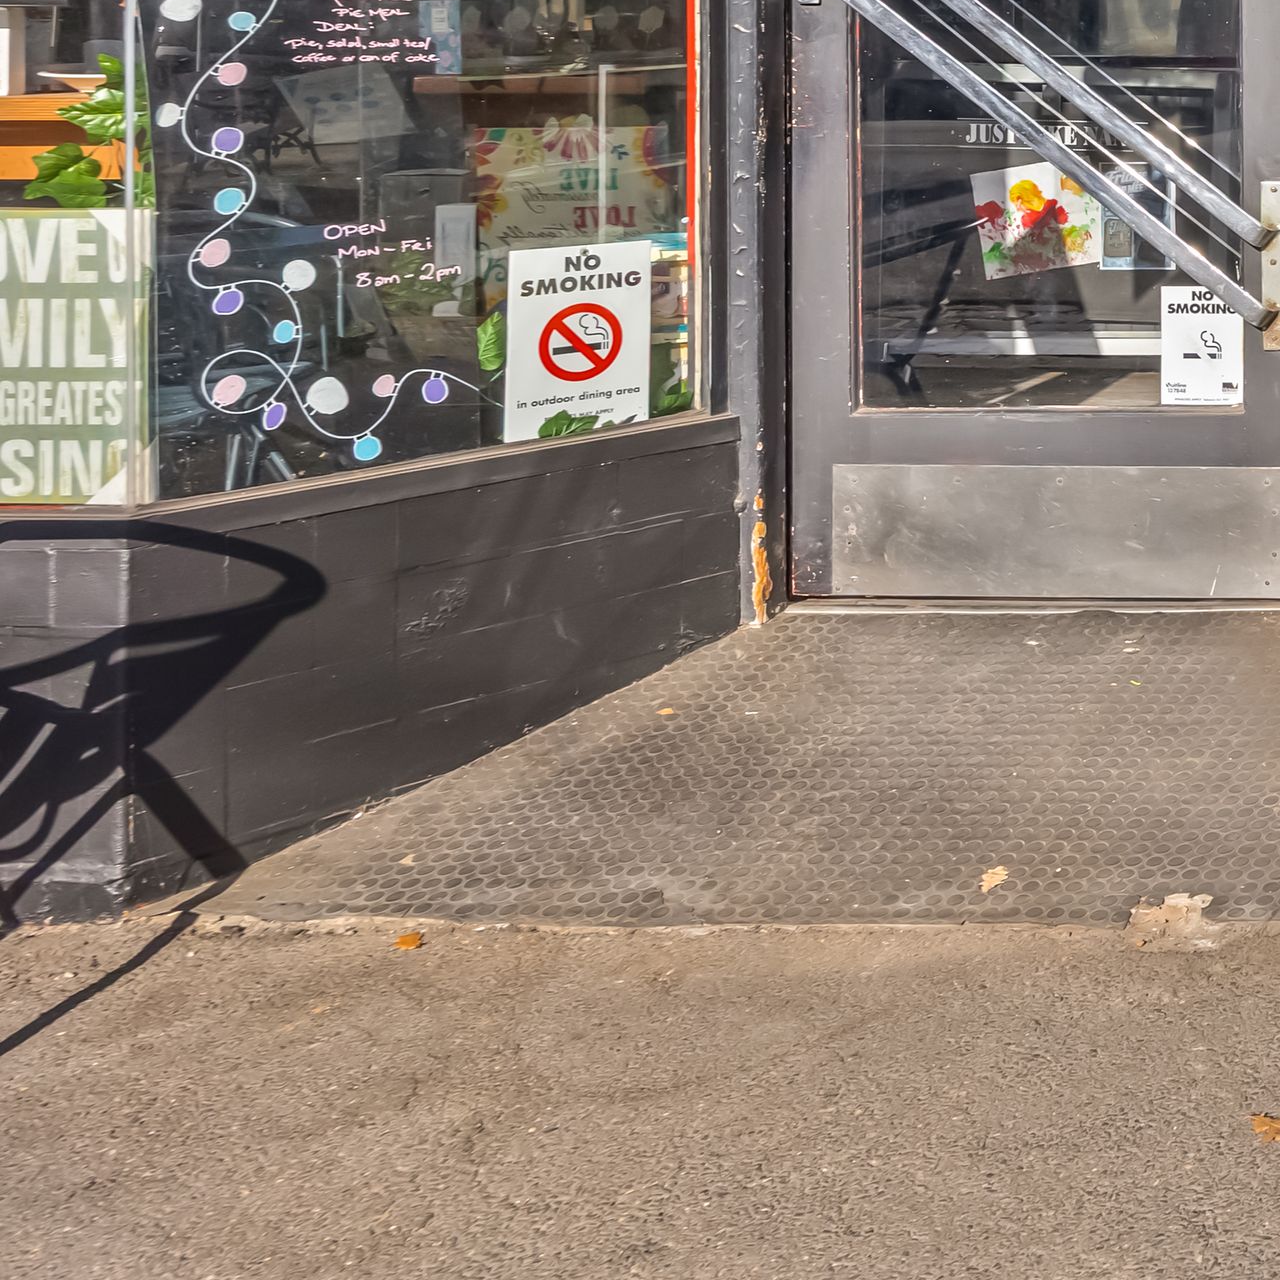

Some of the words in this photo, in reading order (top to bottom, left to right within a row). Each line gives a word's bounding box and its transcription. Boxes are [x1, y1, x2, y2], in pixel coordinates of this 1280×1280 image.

[965, 123, 1017, 144] JUST
[323, 218, 387, 240] OPEN
[564, 254, 601, 272] NO
[519, 270, 642, 298] SMOKING
[1191, 290, 1214, 301] NO
[516, 400, 528, 410] in
[530, 393, 575, 408] outdoor
[578, 389, 613, 403] dining
[615, 386, 641, 398] area
